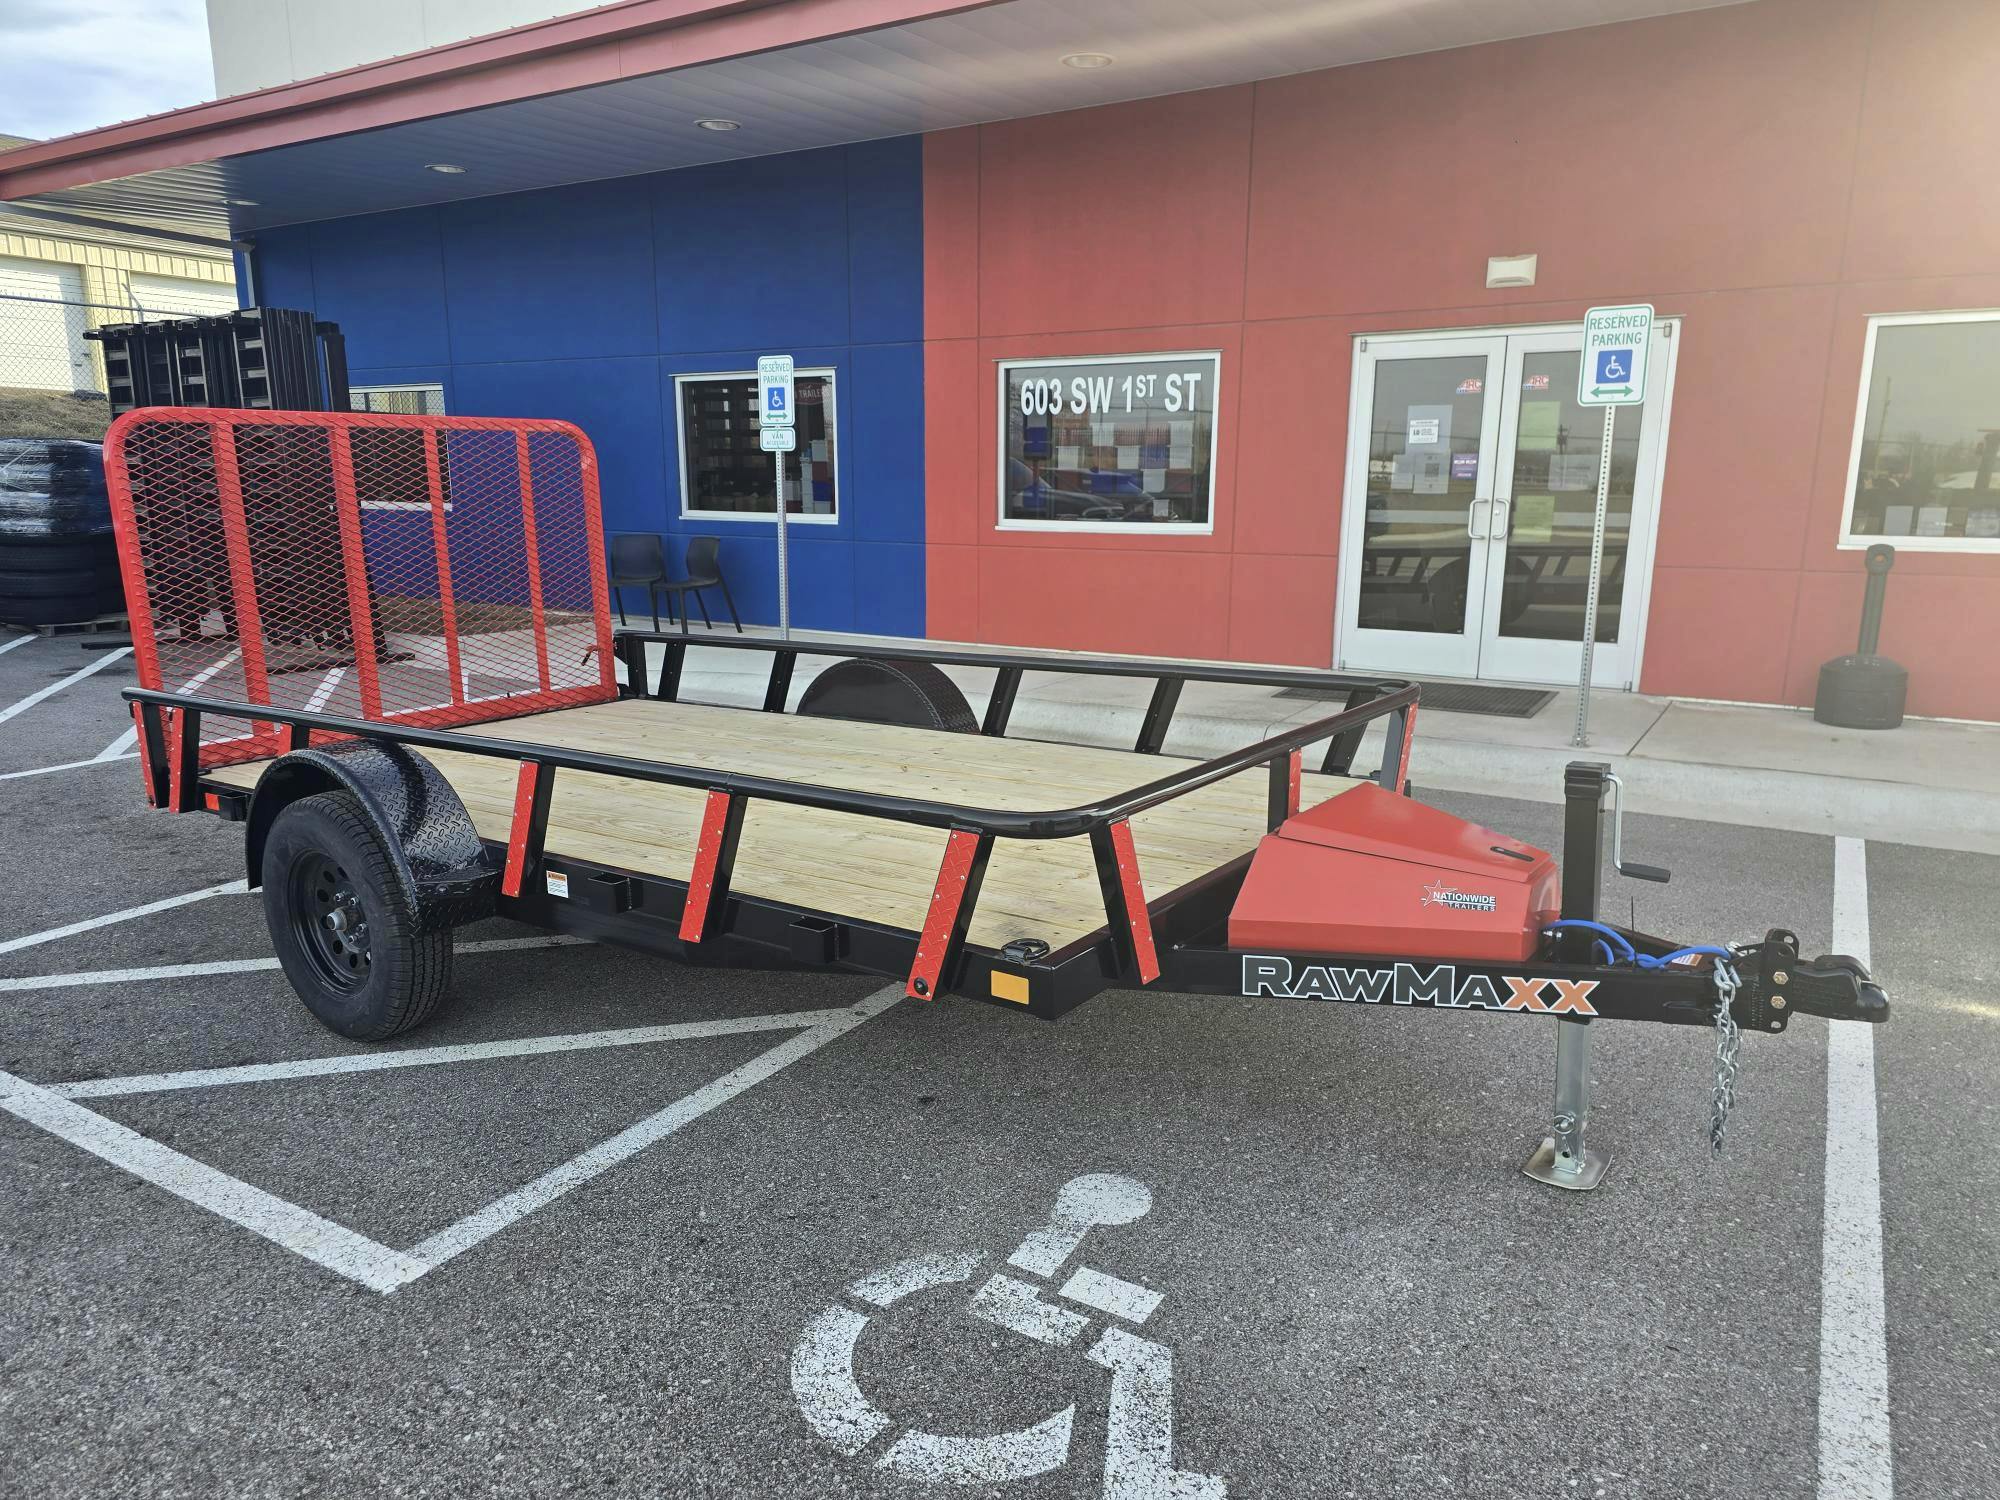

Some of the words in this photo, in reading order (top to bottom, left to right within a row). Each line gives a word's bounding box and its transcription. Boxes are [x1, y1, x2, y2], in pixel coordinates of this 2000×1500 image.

[1590, 315, 1647, 330] RESERVED
[1592, 332, 1642, 346] PARKING
[761, 363, 790, 372] RESERVED
[763, 375, 788, 383] PARKING
[798, 389, 822, 399] TRAILE
[1020, 378, 1062, 415] 603
[1070, 376, 1113, 414] SW
[1164, 372, 1202, 412] ST
[1433, 891, 1496, 904] NATIONWIDE
[1449, 902, 1496, 912] TRAILERS
